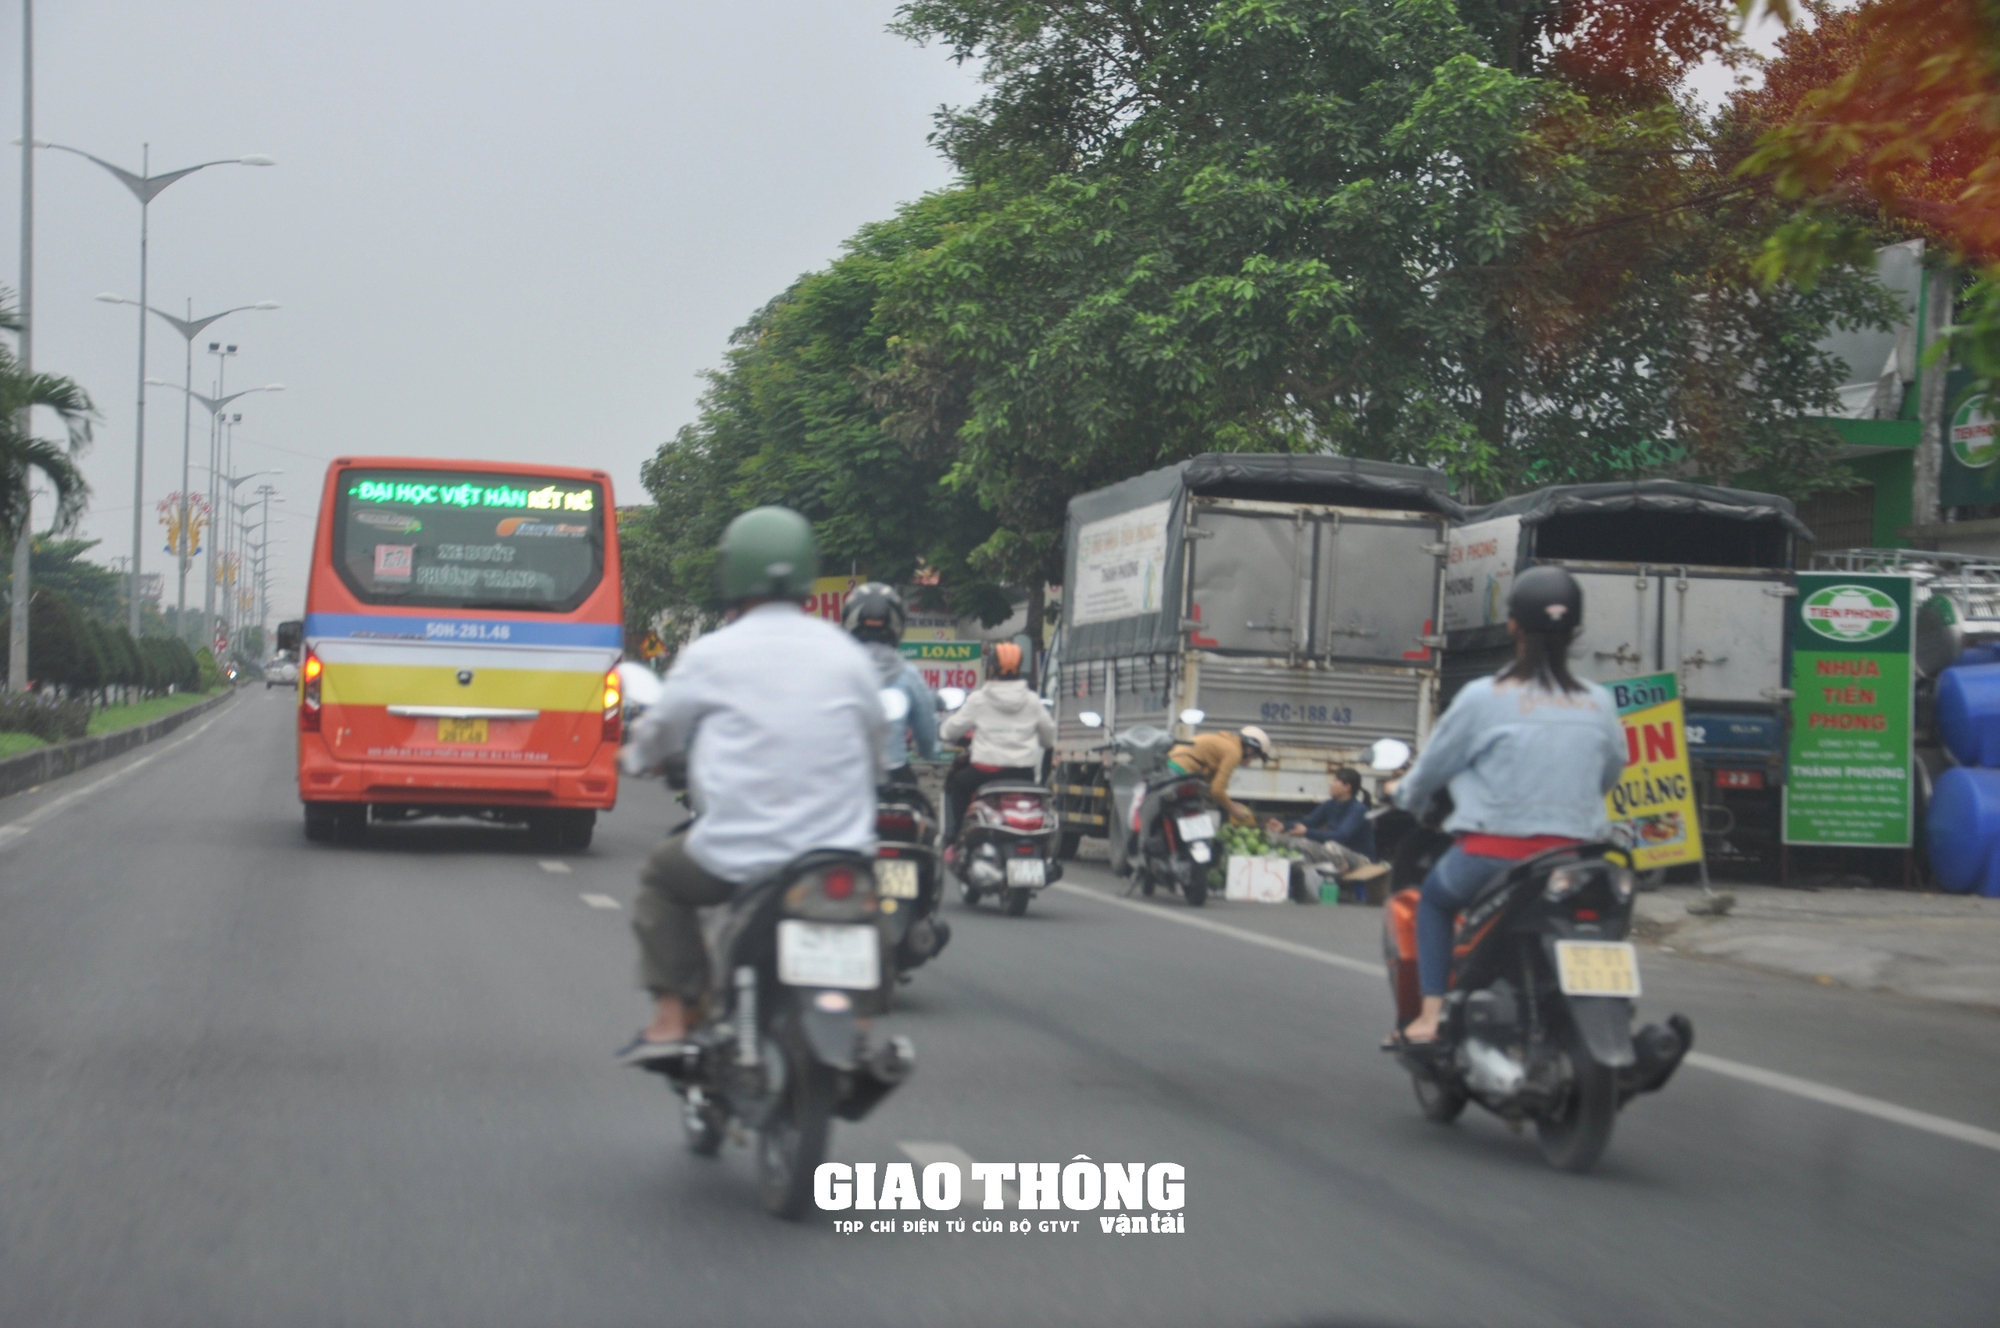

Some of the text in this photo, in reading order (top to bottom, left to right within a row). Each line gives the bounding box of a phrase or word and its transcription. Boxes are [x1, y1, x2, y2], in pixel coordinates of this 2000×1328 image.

[358, 481, 393, 503] ĐẠI
[394, 483, 438, 505] HỌC
[439, 483, 483, 508] VIỆT
[1844, 608, 1893, 620] PHONG
[921, 645, 971, 658] LOAN
[1808, 712, 1888, 732] PHONG
[1612, 767, 1687, 816] QUẢNG
